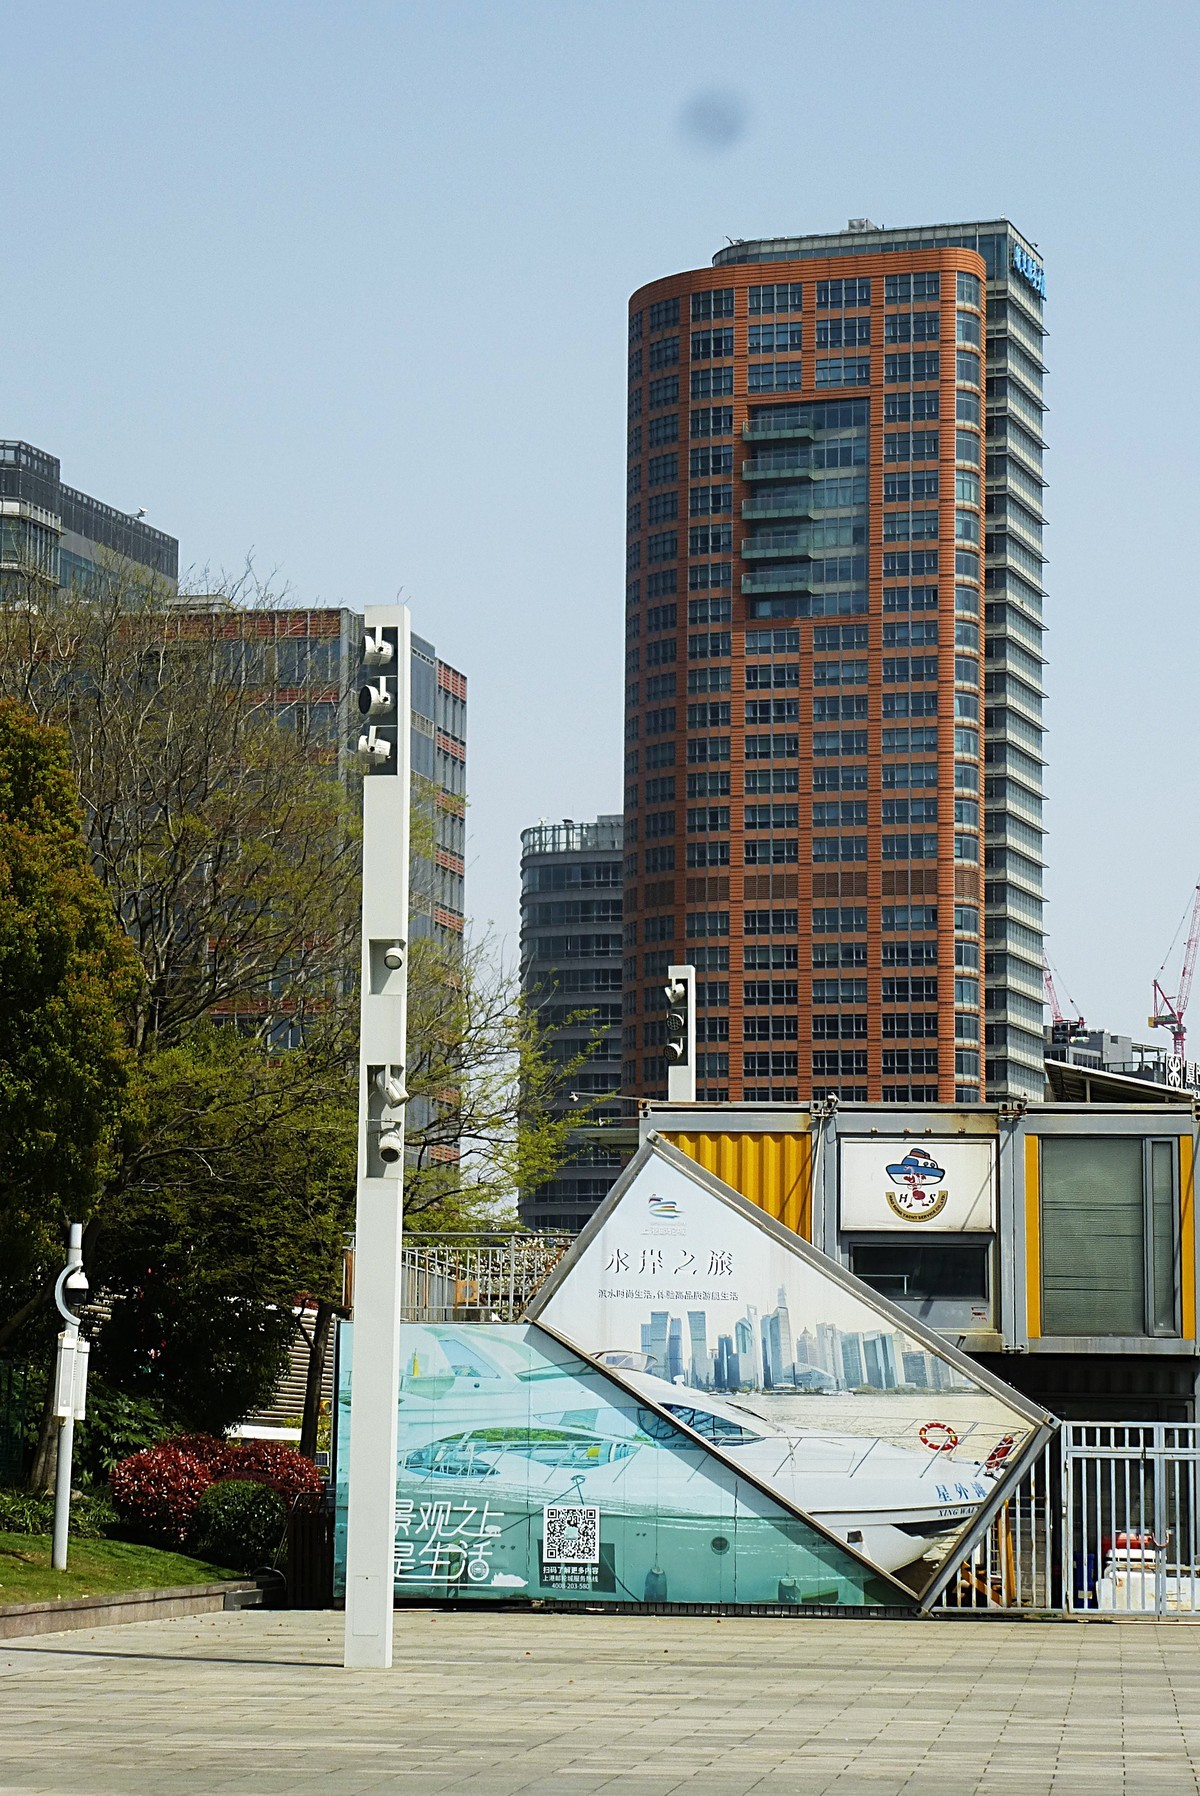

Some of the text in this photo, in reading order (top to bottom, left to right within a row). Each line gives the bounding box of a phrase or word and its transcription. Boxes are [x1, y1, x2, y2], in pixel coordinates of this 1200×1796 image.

[899, 1193, 936, 1203] H S
[918, 1210, 936, 1219] SERVICE
[605, 1248, 733, 1276] 水岸之旅
[938, 1509, 958, 1517] XING
[960, 1507, 975, 1515] WAI
[394, 1540, 493, 1581] 是生活
[543, 1566, 599, 1575] 扫码了解更多内容
